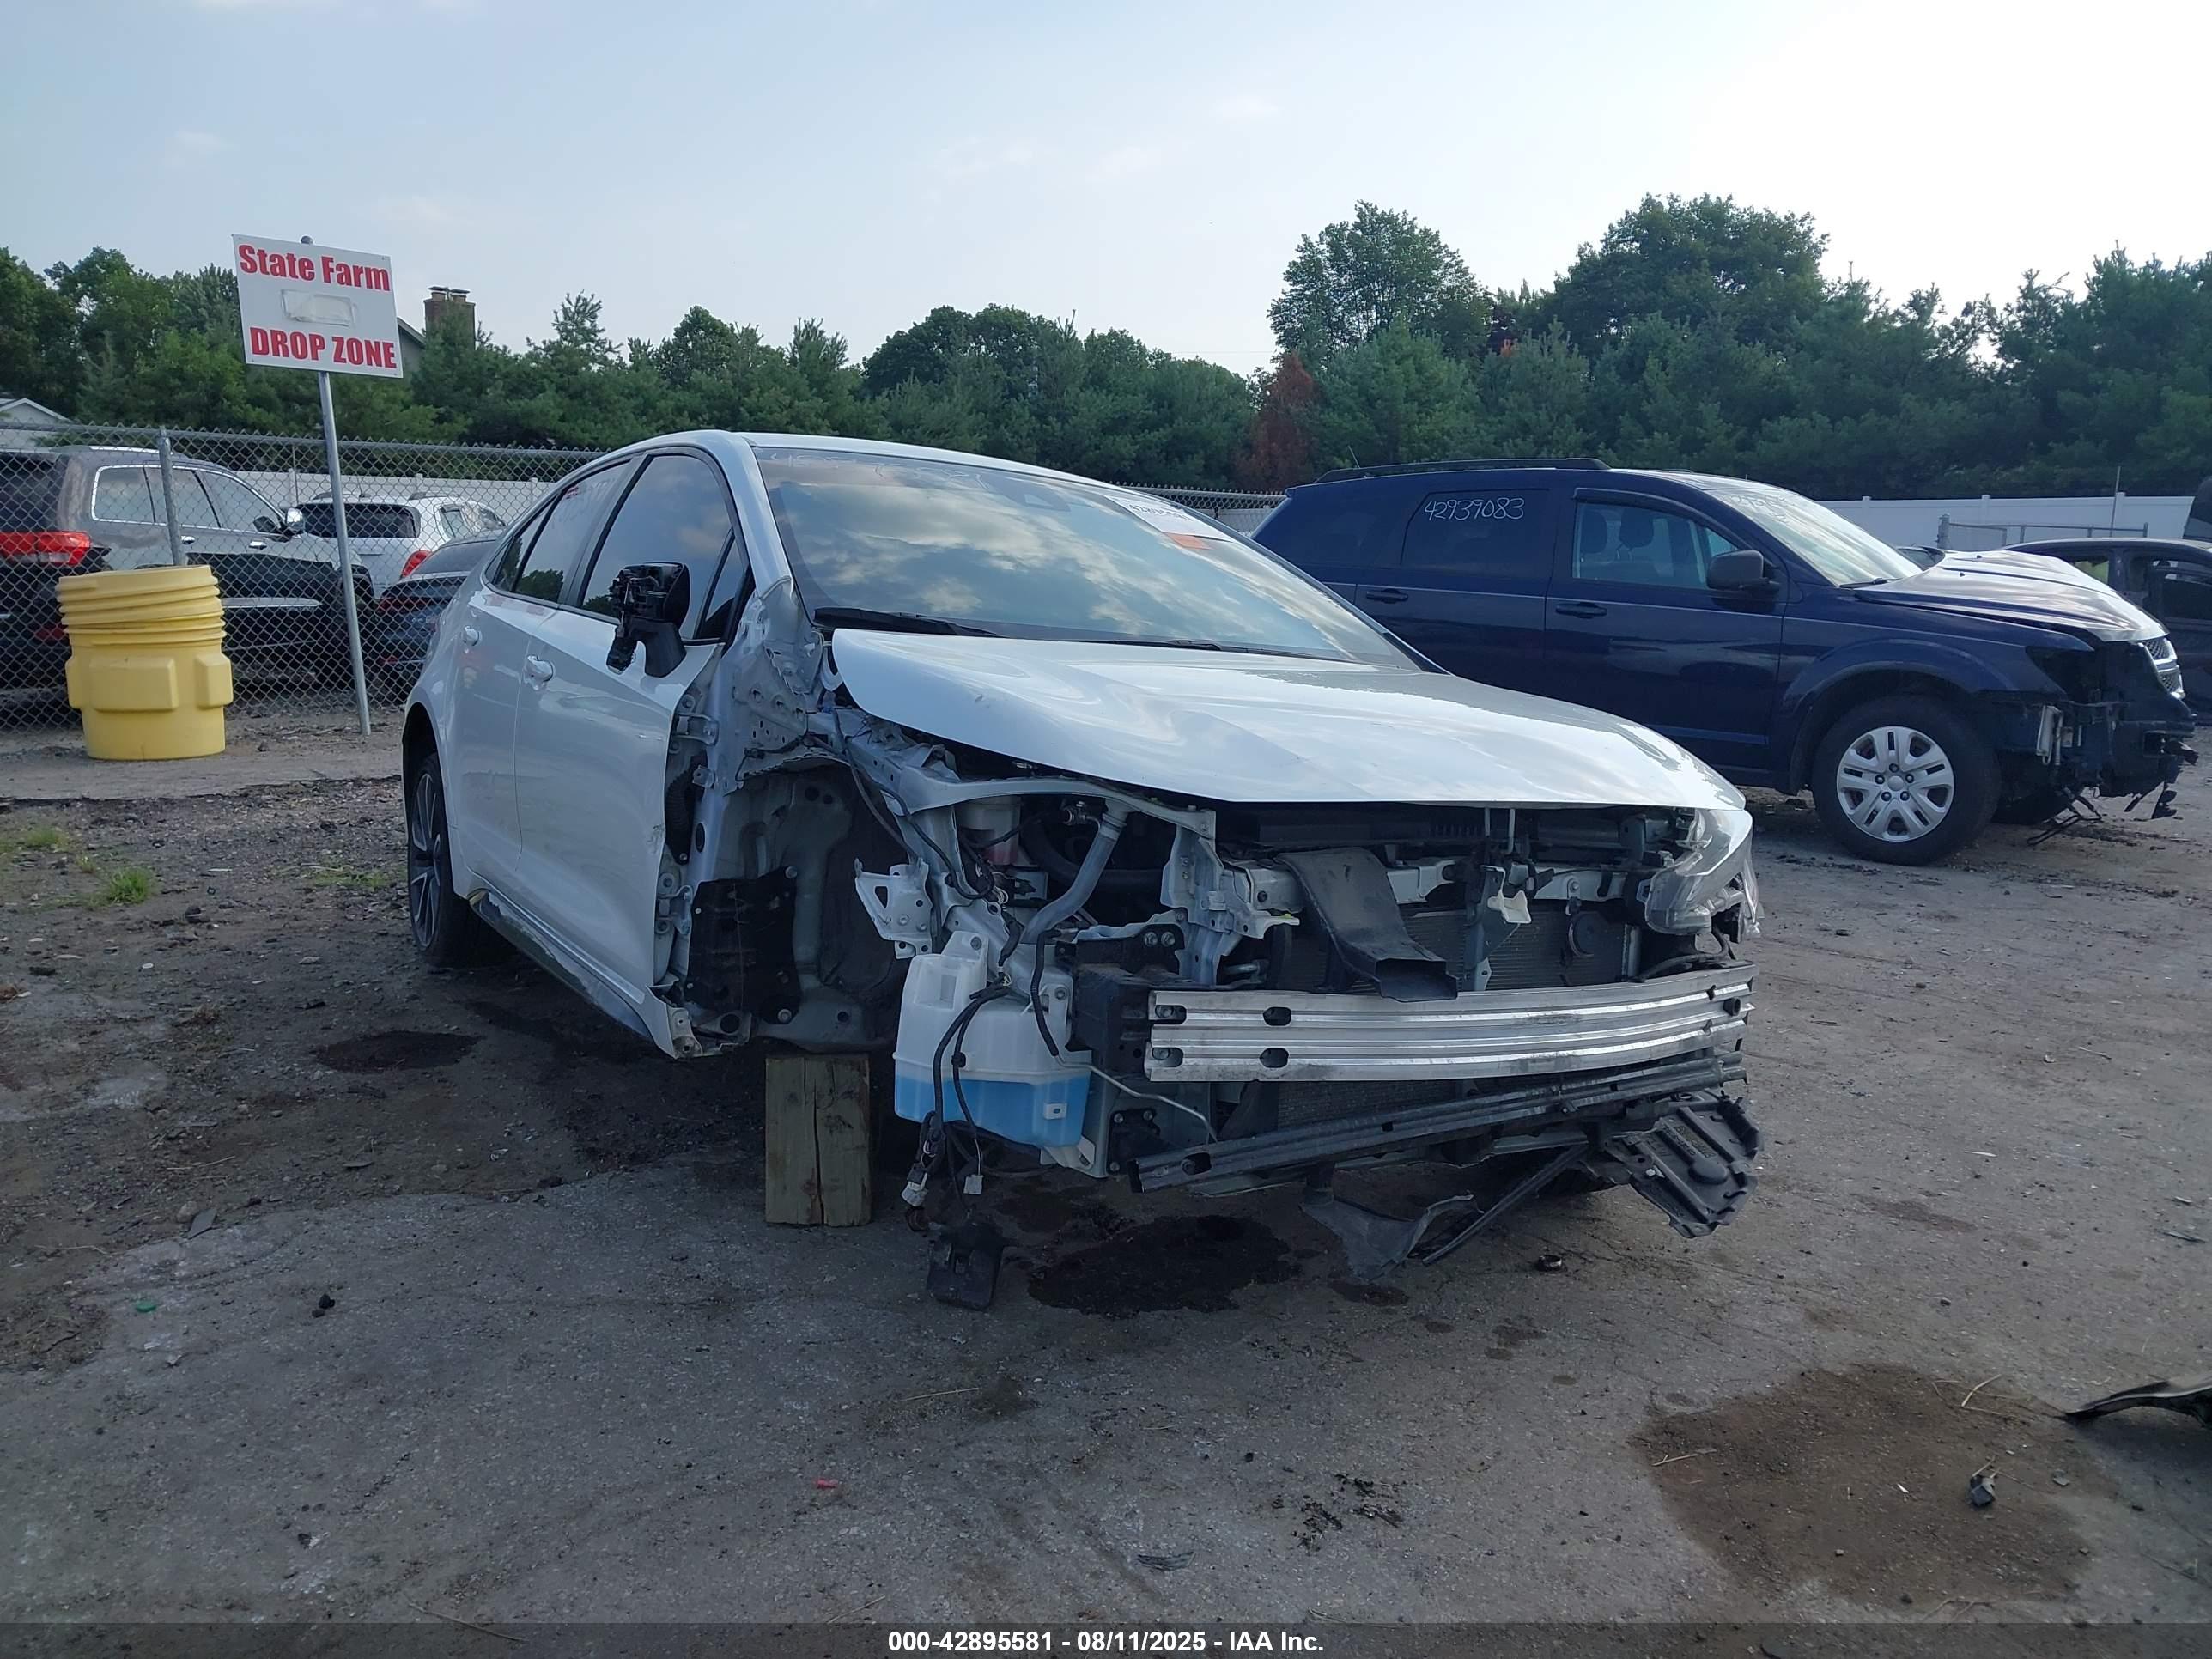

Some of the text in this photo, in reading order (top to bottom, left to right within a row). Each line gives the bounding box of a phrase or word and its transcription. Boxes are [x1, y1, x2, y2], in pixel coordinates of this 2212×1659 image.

[238, 244, 391, 291] State Farm
[249, 327, 397, 368] DROP ZONE
[1425, 497, 1525, 521] 42939083
